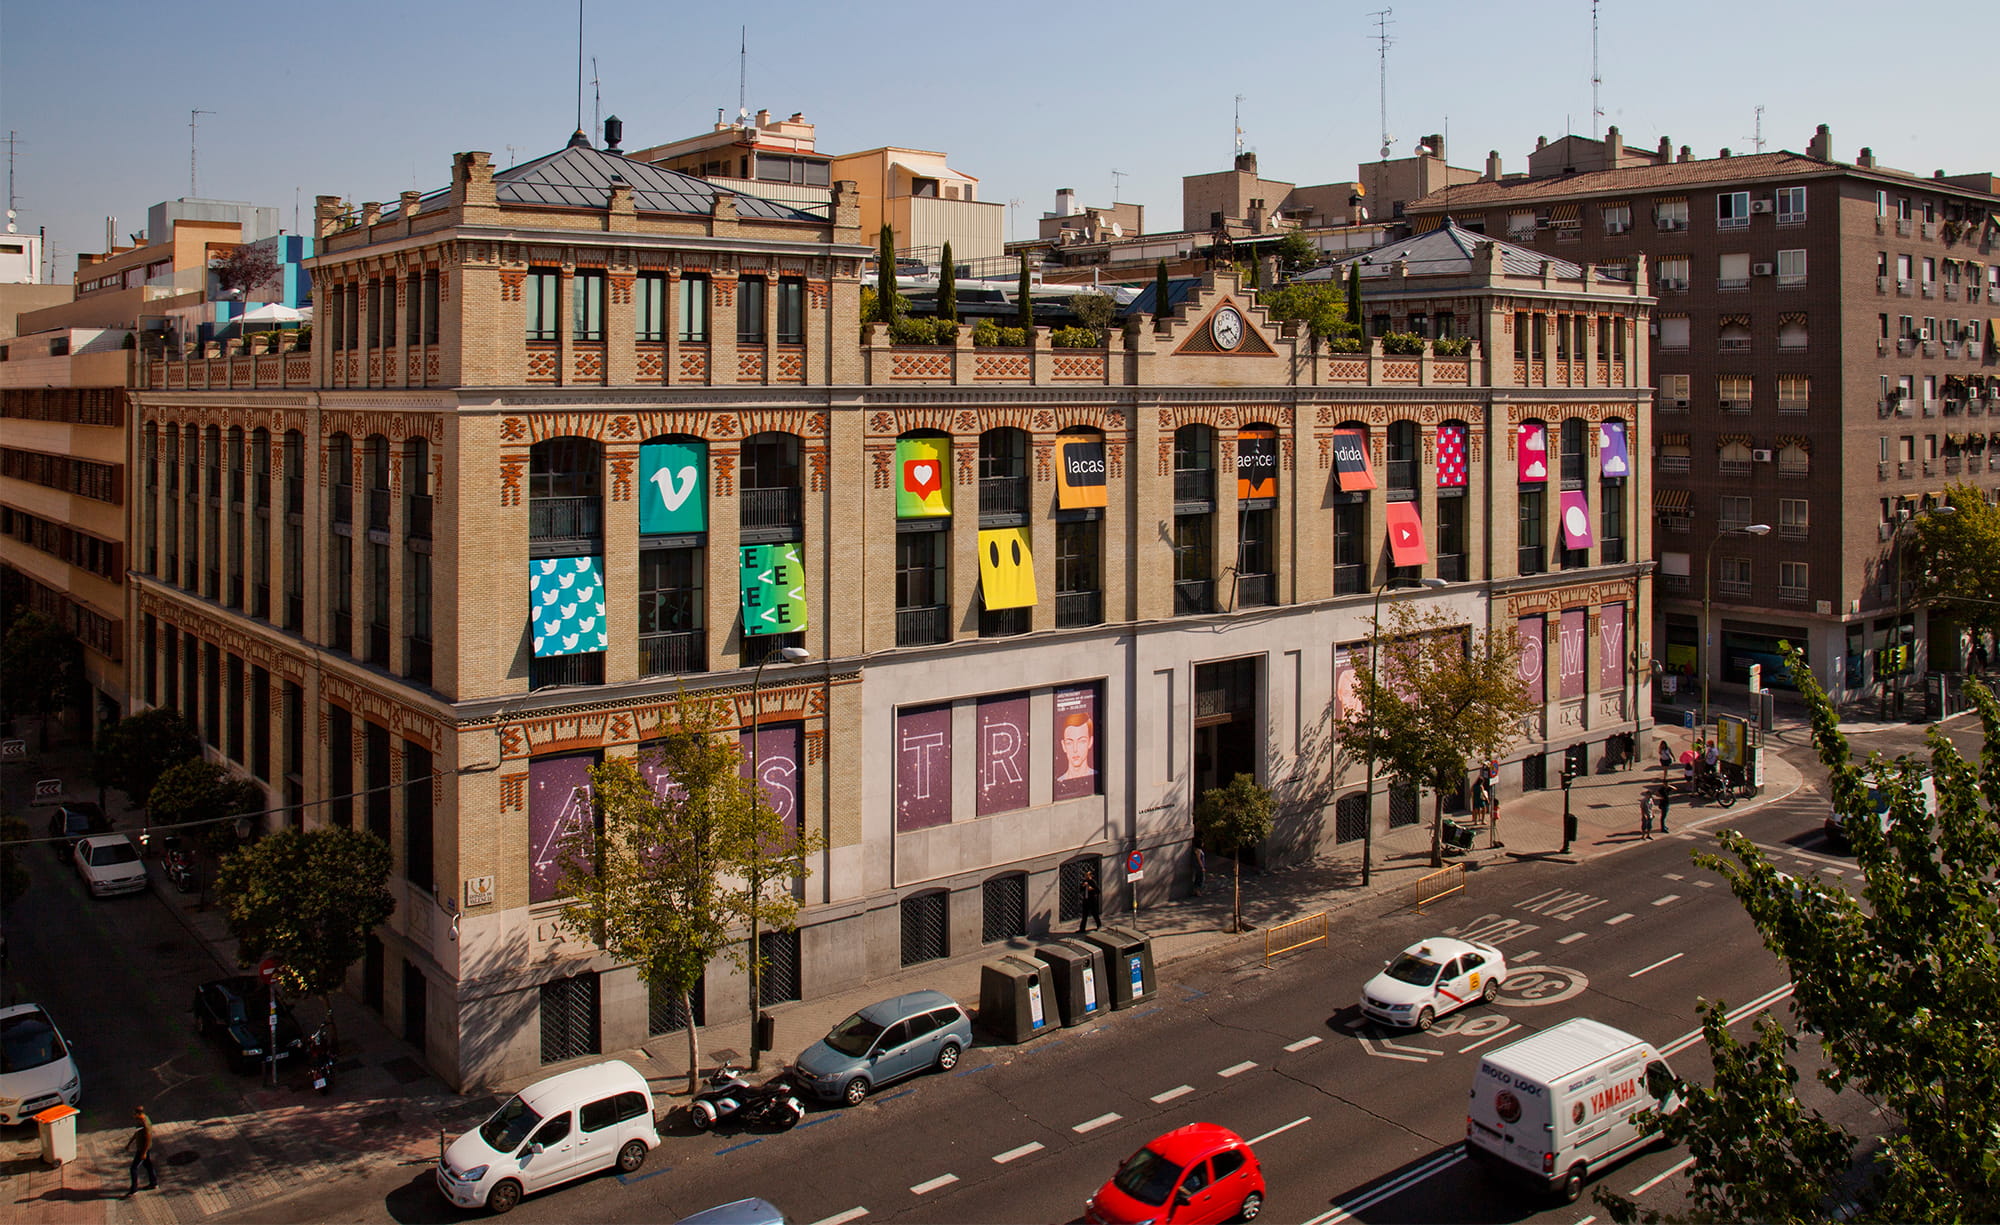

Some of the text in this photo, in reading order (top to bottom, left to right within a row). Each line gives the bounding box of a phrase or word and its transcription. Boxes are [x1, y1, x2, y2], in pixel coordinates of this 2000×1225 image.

[1067, 456, 1105, 473] lacas
[903, 723, 1022, 799] T R
[1512, 888, 1608, 921] TAXI
[1501, 973, 1566, 998] 30
[1590, 1078, 1636, 1115] YAMAHA
